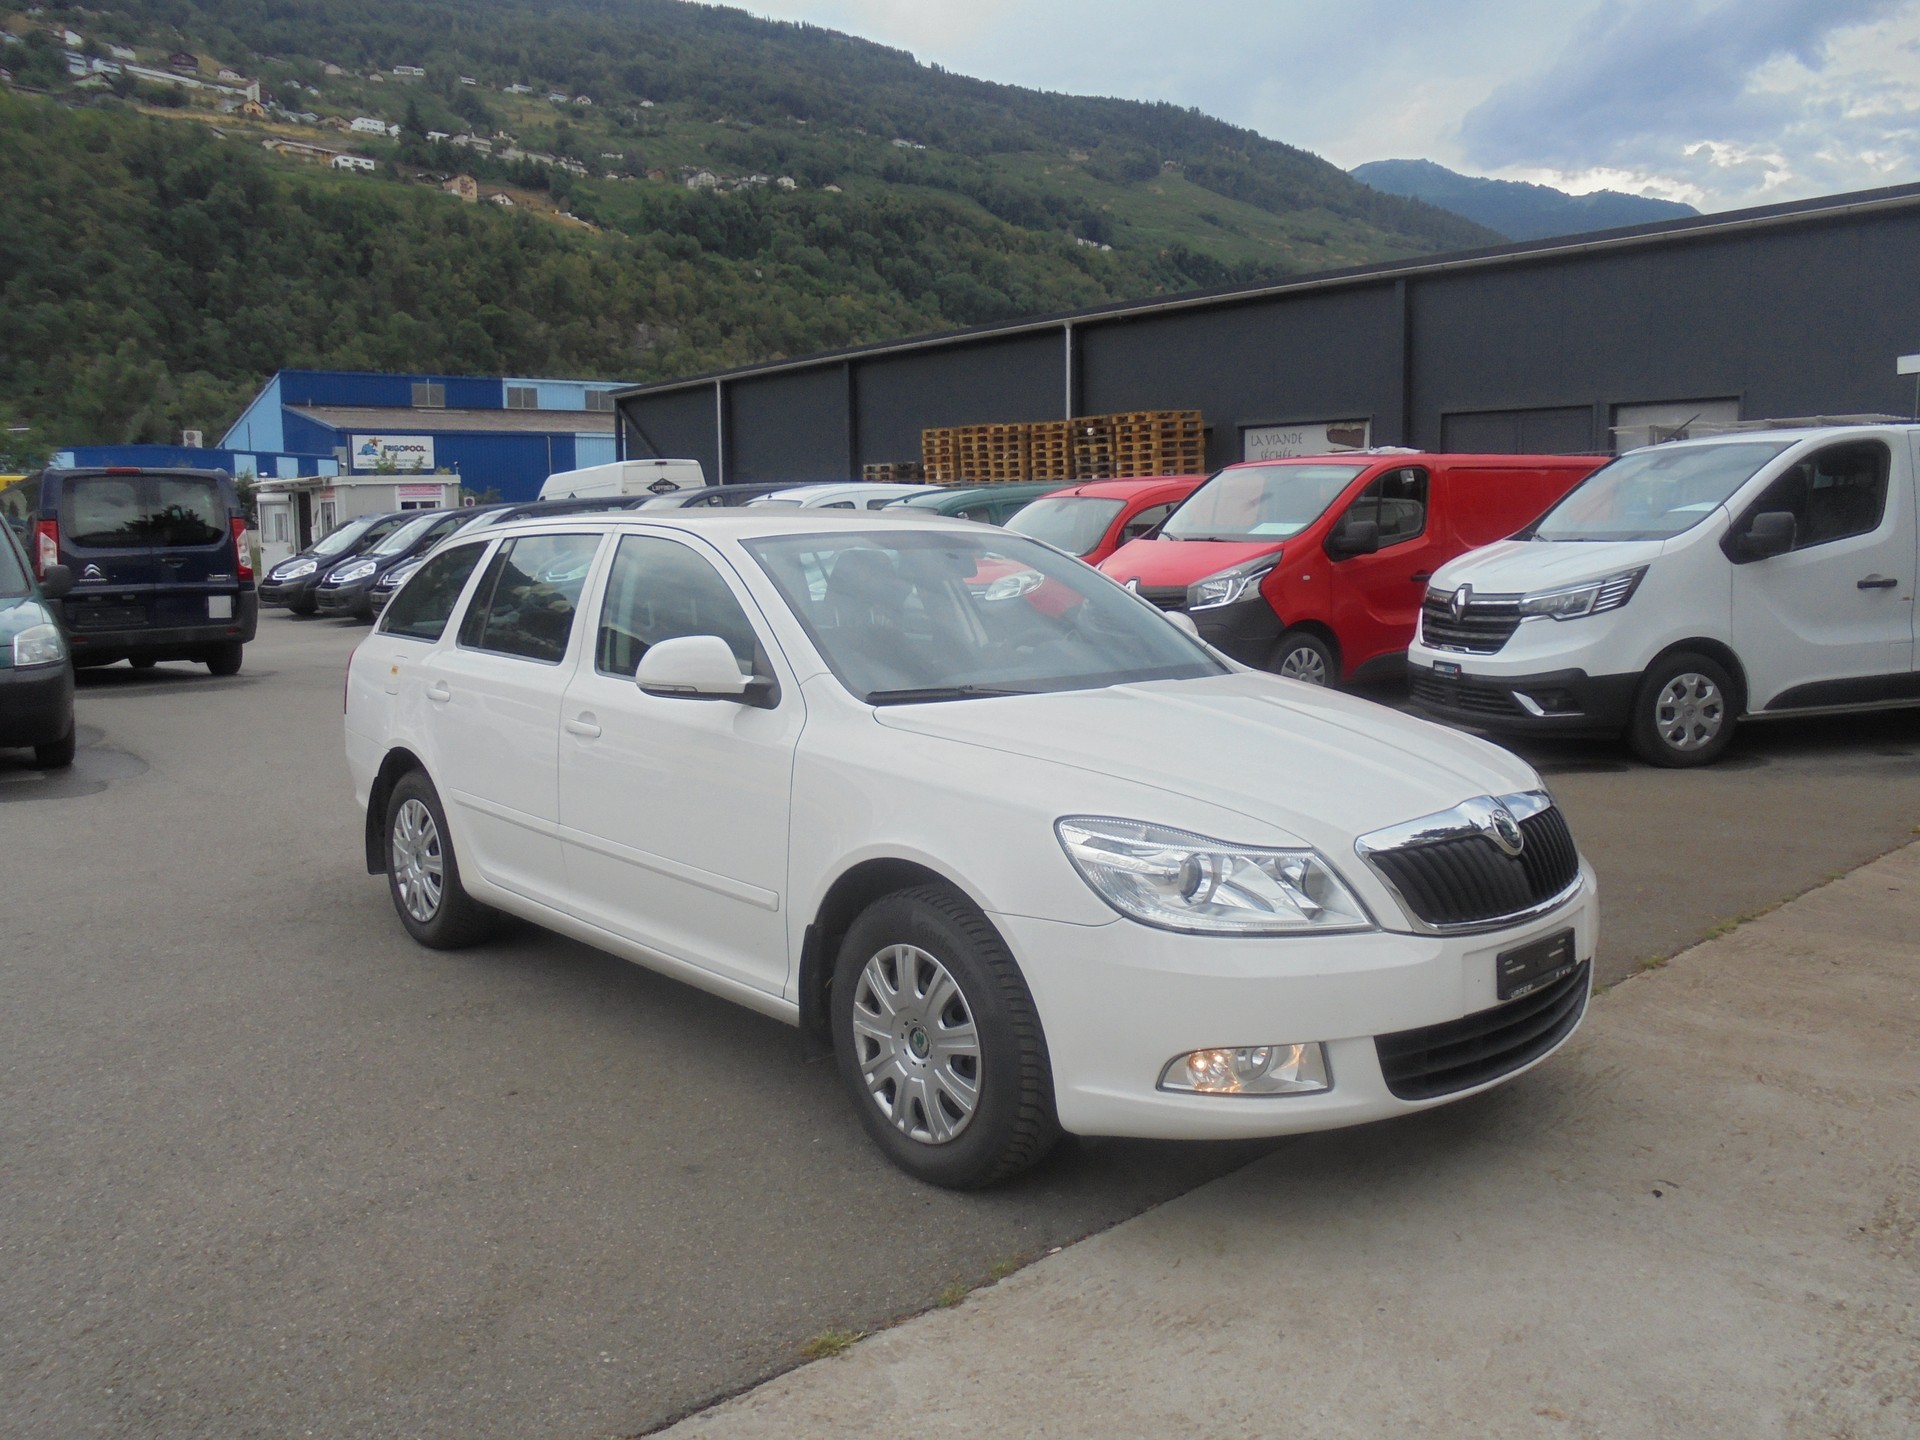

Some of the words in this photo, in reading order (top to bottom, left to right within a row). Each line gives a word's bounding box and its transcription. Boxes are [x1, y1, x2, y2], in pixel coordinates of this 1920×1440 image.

[1251, 434, 1264, 447] LA
[1265, 432, 1303, 446] VIANDE
[383, 444, 426, 452] FRIGOPOOL
